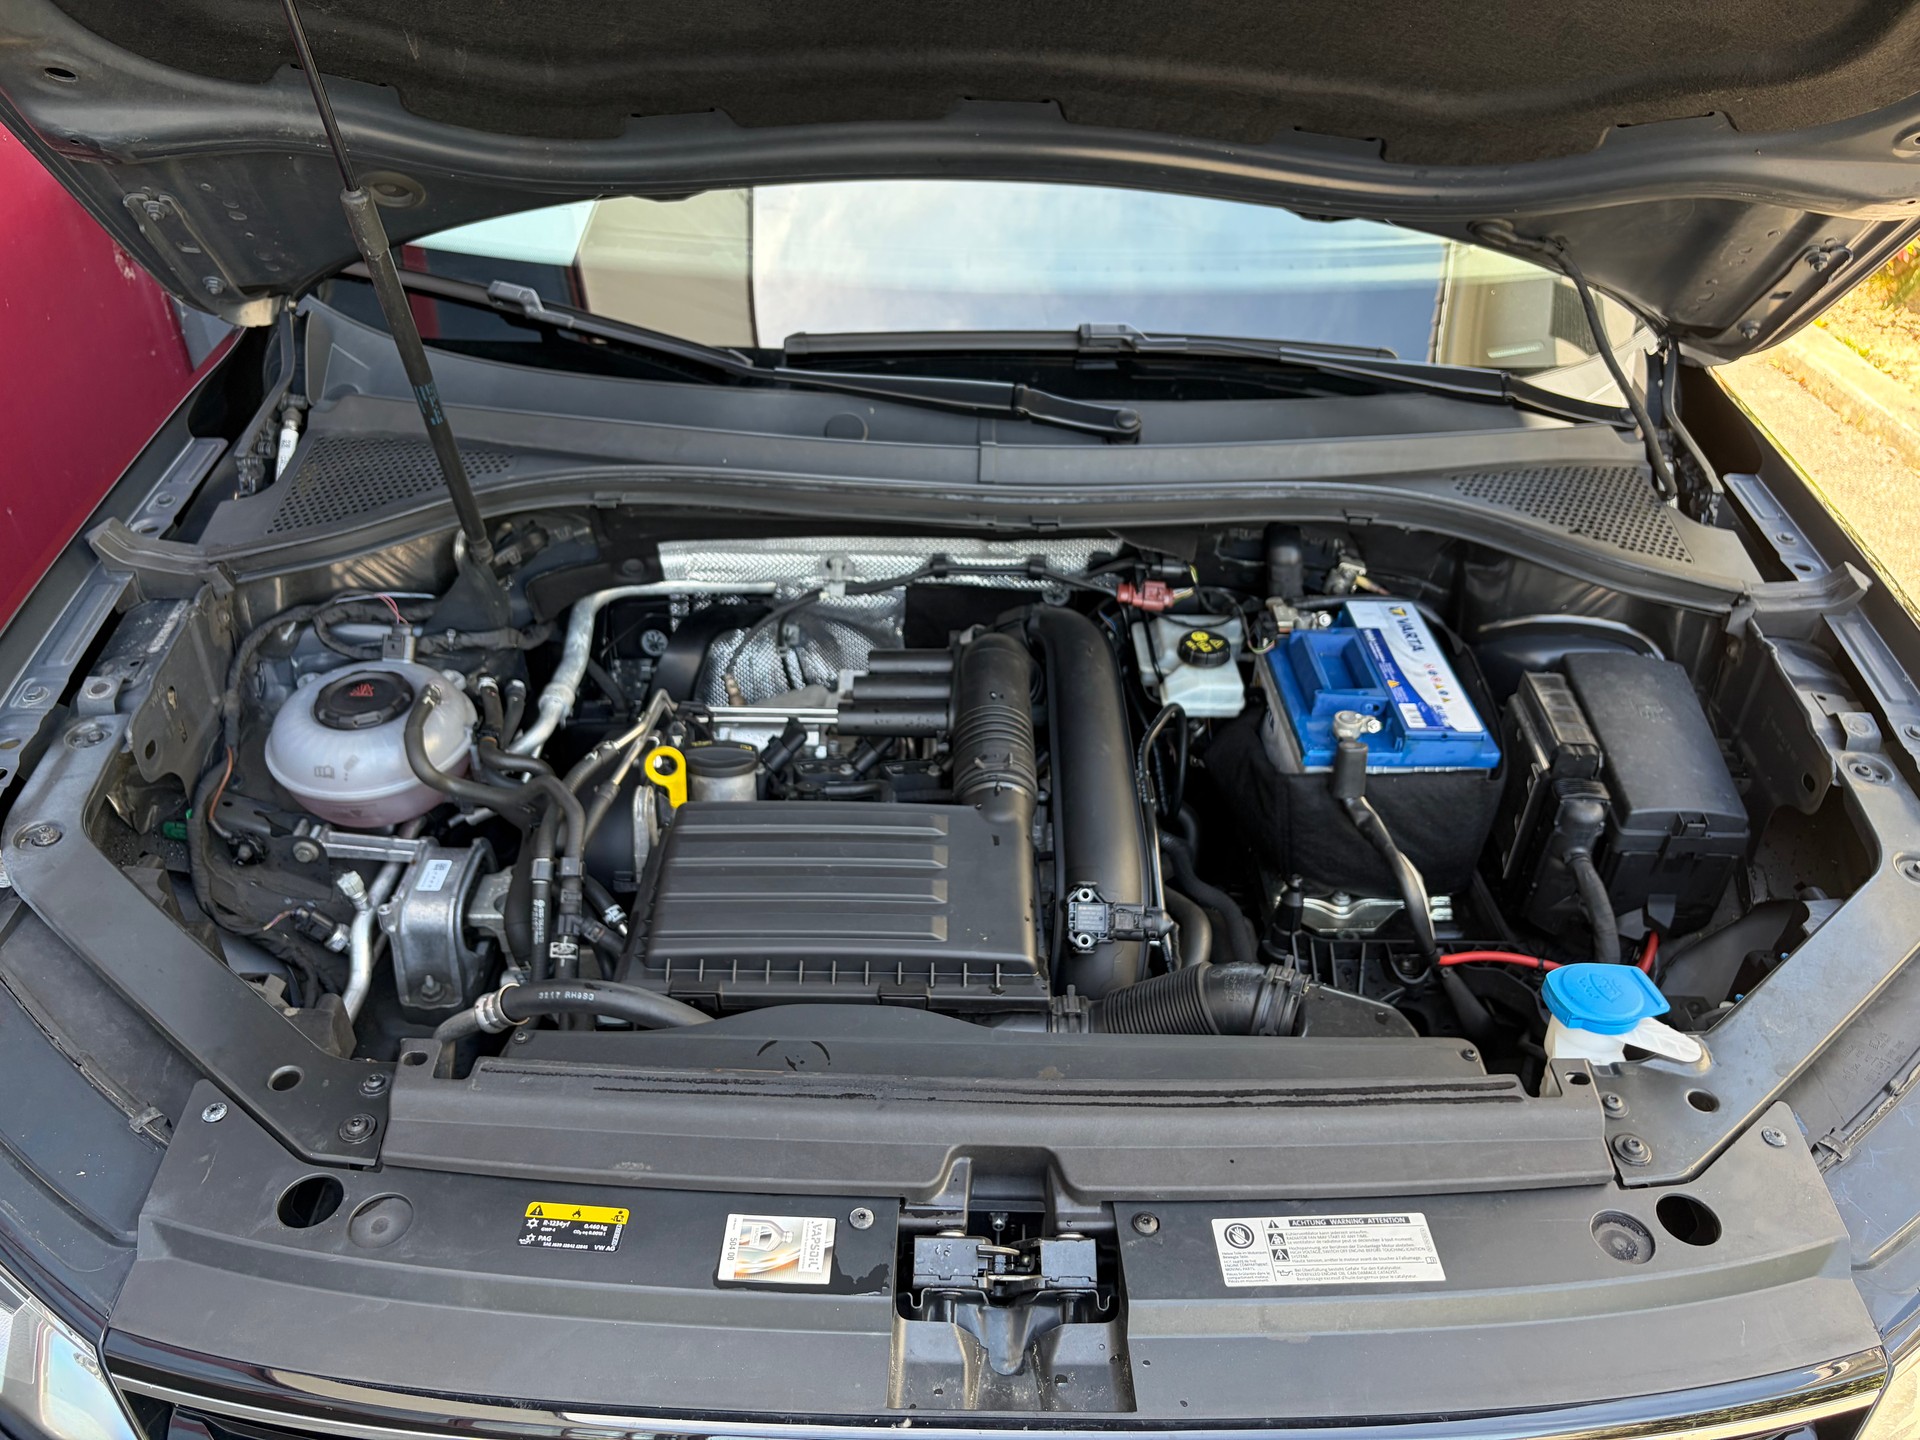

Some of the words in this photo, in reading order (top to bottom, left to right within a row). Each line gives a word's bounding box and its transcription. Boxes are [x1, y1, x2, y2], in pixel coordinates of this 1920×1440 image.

[1397, 618, 1425, 651] VARTA
[543, 1220, 570, 1229] R-1234yf
[729, 1237, 737, 1249] 504
